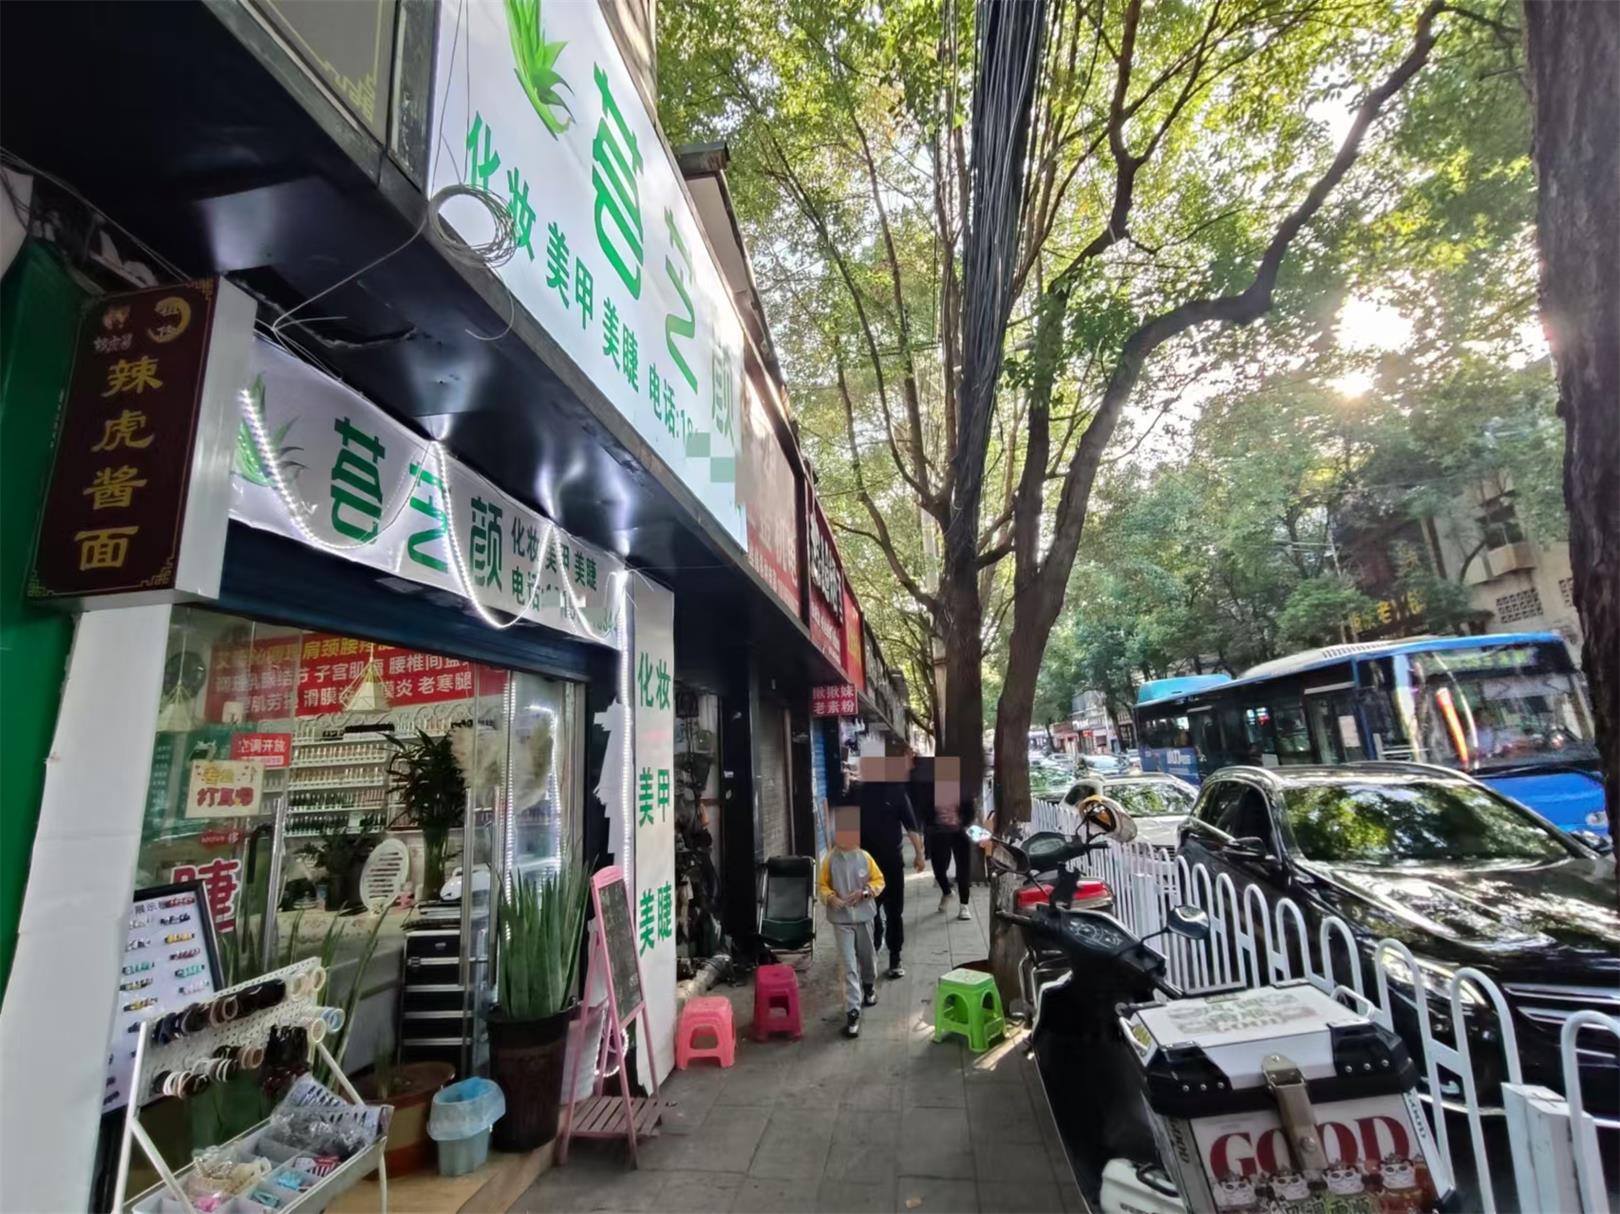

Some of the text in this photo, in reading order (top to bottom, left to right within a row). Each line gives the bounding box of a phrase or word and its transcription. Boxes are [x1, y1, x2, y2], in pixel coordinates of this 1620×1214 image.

[466, 110, 536, 262] 化妆
[546, 221, 594, 330] 美甲
[603, 296, 639, 393] 美睫
[74, 355, 163, 571] 辣虎酱面
[511, 516, 540, 563] 化妆
[574, 551, 597, 592] 美睫
[418, 671, 472, 695] 老寒腿
[638, 652, 671, 710] 化妆
[639, 767, 670, 828] 美甲
[640, 881, 672, 957] 美睫
[1210, 1116, 1411, 1180] GOOD
